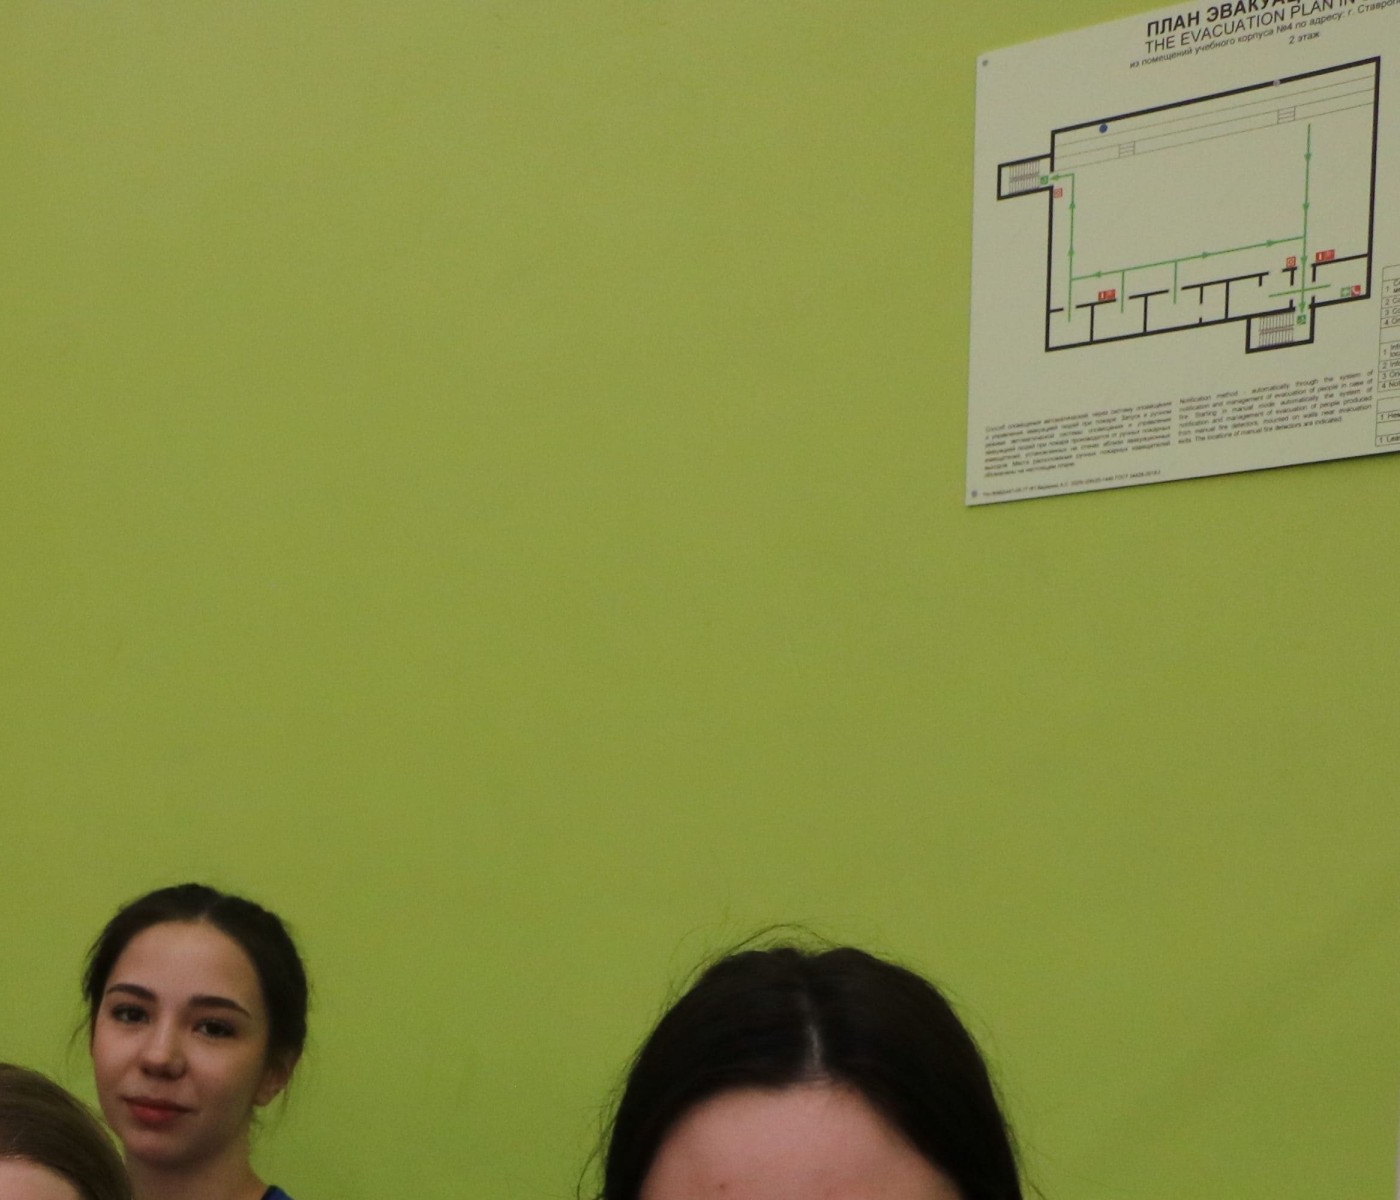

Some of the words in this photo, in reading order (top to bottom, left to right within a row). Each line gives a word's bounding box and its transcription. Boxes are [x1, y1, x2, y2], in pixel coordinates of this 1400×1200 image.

[1145, 35, 1176, 54] THE
[1180, 8, 1285, 46] EVACUATION
[1290, 0, 1333, 19] PLAN
[1147, 11, 1200, 37] ПЛАН
[1195, 37, 1236, 55] учебного
[1237, 29, 1274, 45] корпуса
[1295, 20, 1306, 29] по
[1289, 35, 1295, 44] 2
[1298, 31, 1320, 42] этаж
